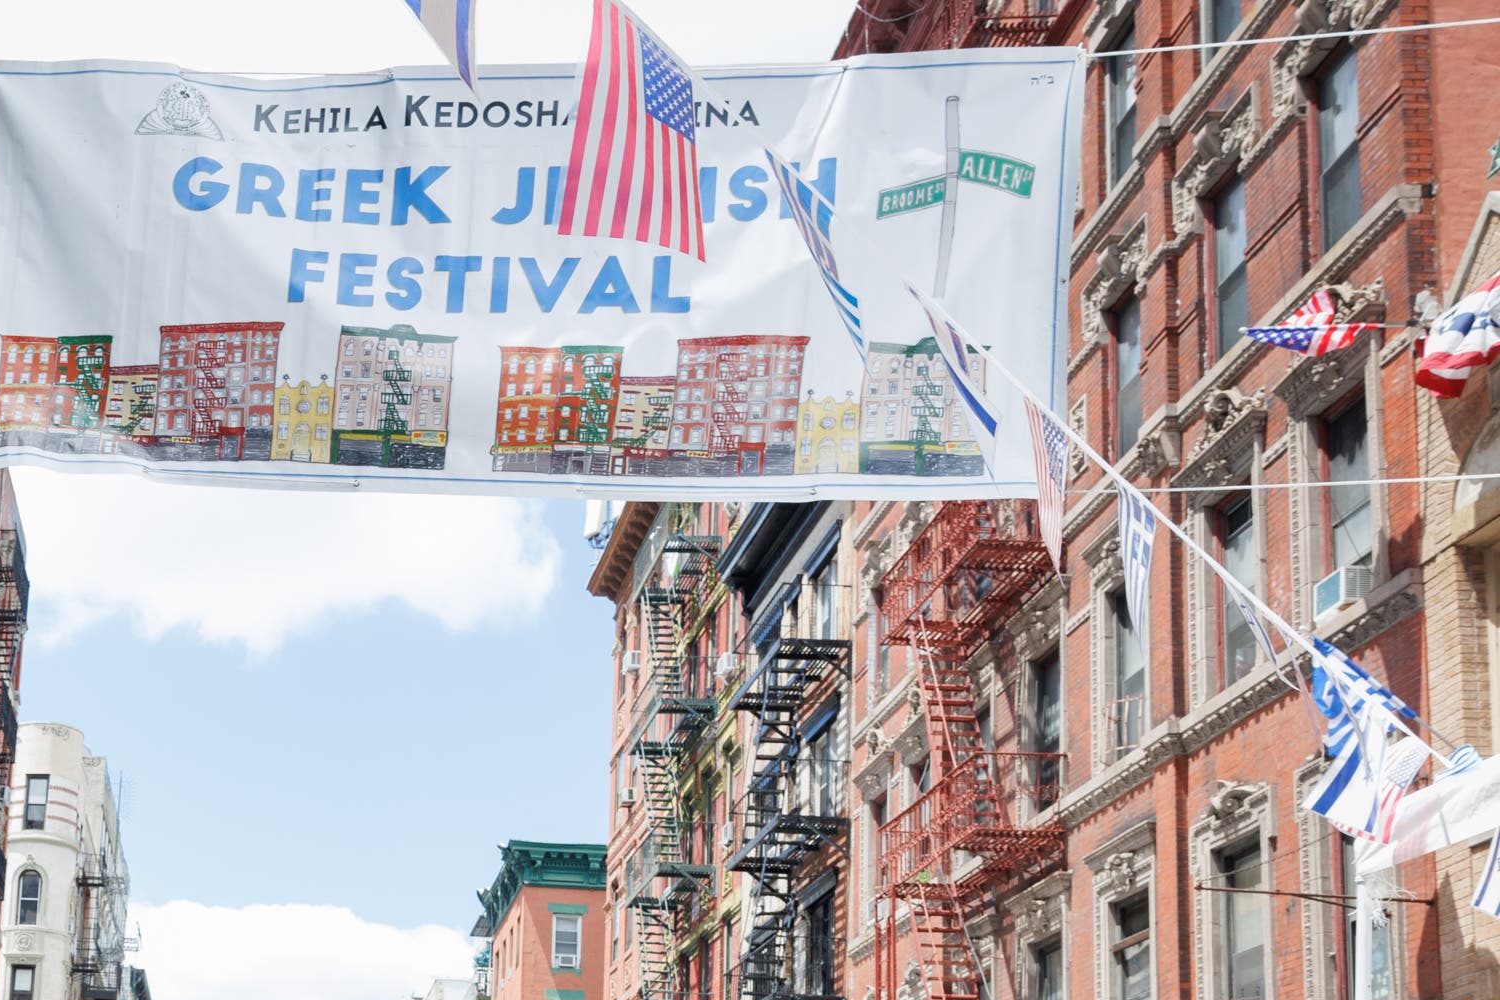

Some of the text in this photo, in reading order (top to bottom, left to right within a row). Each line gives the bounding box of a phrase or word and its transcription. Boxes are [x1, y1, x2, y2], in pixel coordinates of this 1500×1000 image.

[171, 156, 838, 226] GREEK JISH
[961, 155, 1024, 190] ALLEN
[881, 184, 934, 213] BROOME
[287, 248, 691, 314] FESTIVAL
